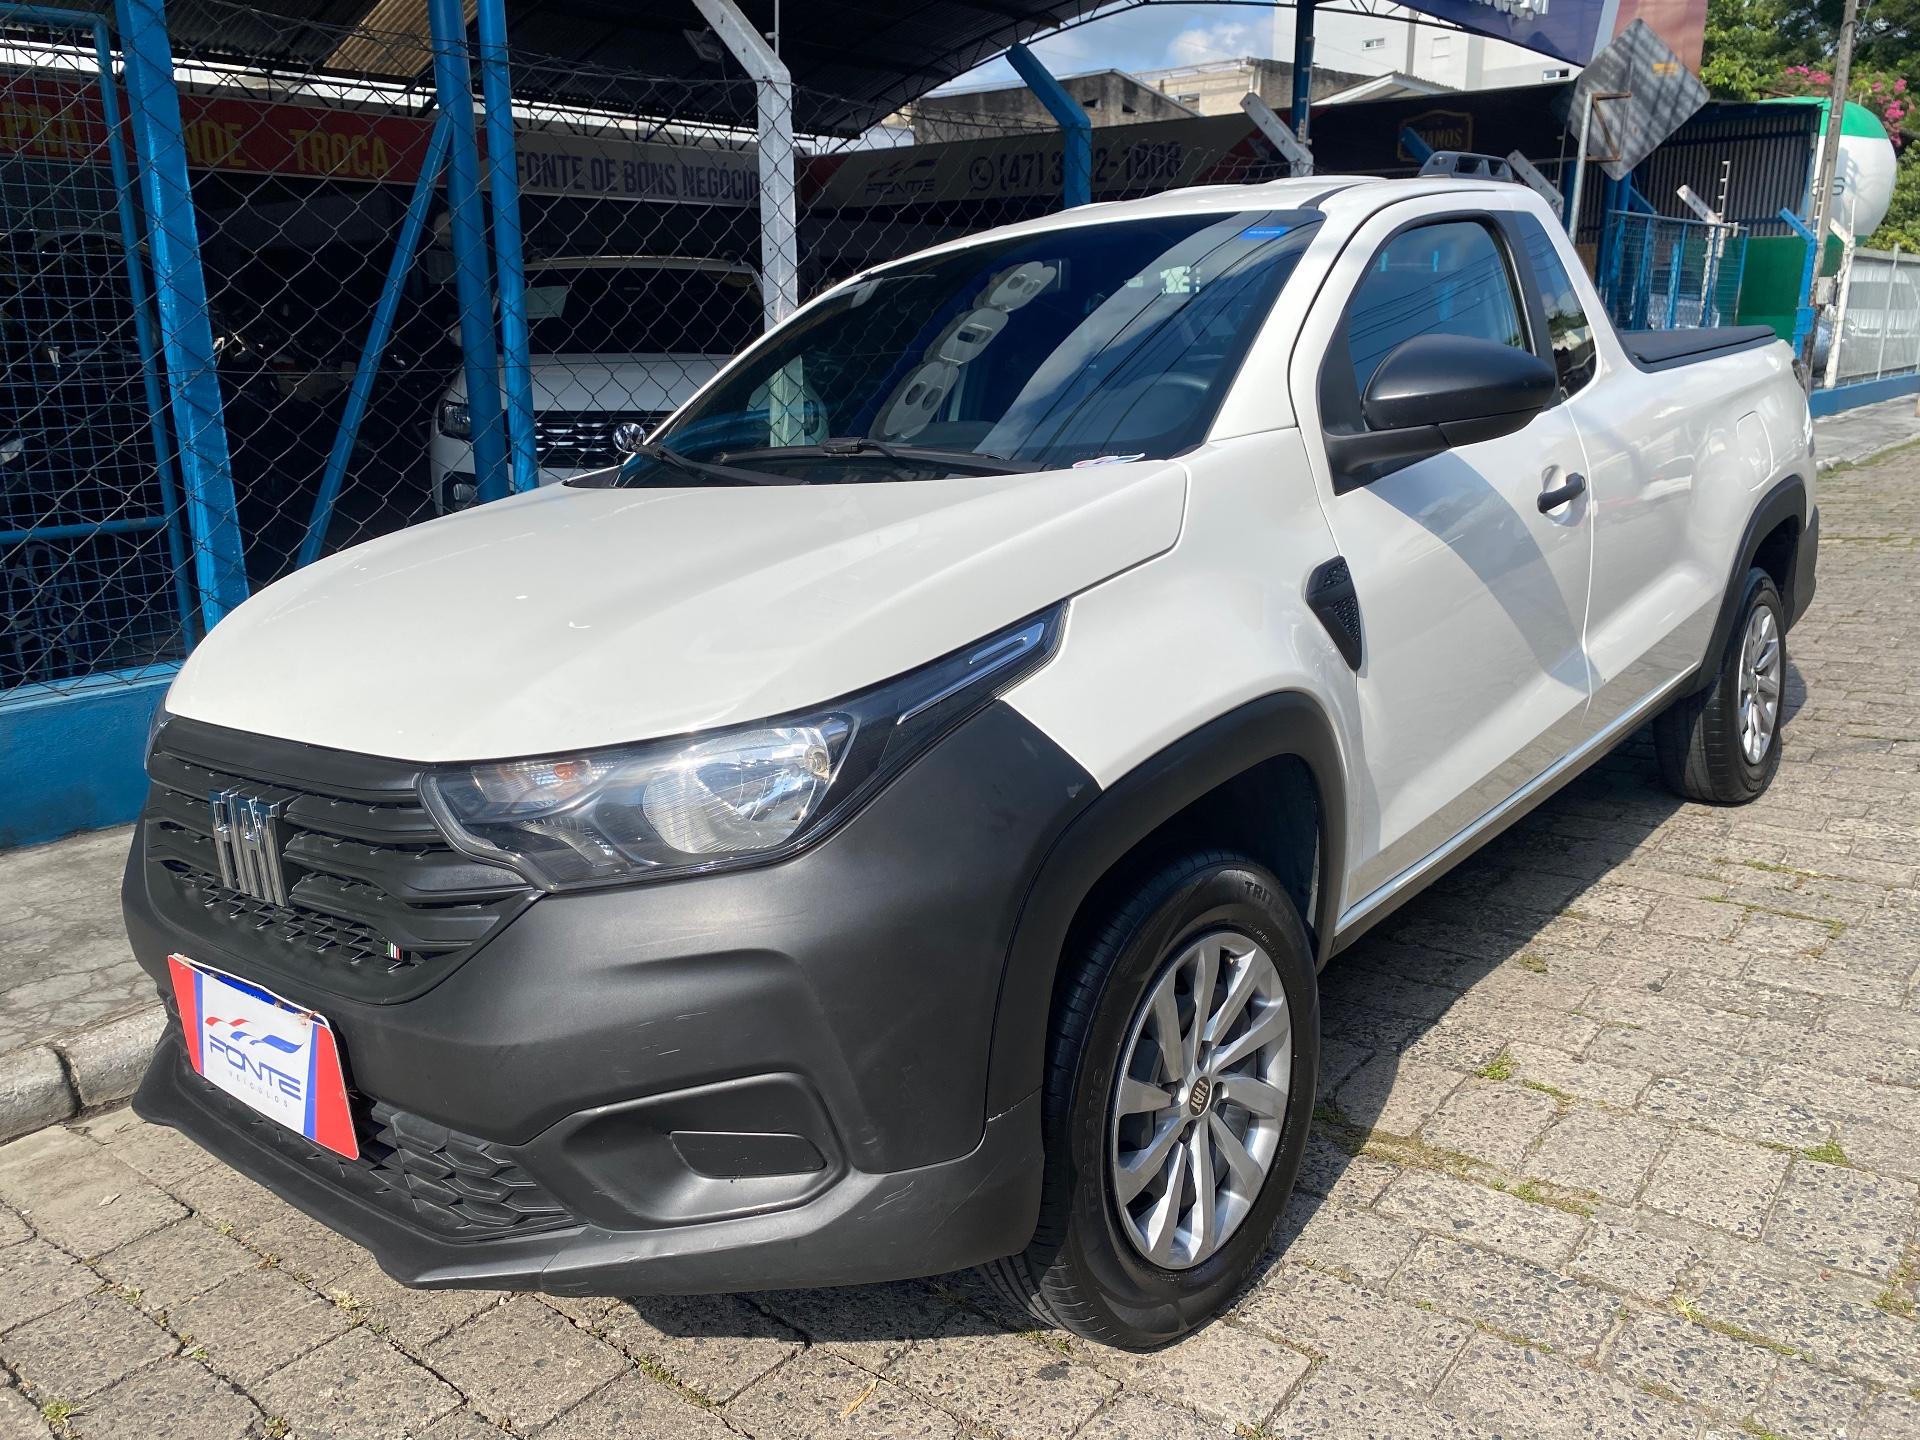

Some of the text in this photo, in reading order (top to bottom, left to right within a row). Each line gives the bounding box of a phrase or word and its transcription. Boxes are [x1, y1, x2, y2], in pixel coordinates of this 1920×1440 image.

[185, 118, 247, 167] NDE
[289, 128, 391, 177] TROCA
[516, 152, 759, 201] FONTE DE BONS NEGÓCIO
[208, 1034, 302, 1101] FONTE
[1190, 1080, 1209, 1112] FIAT
